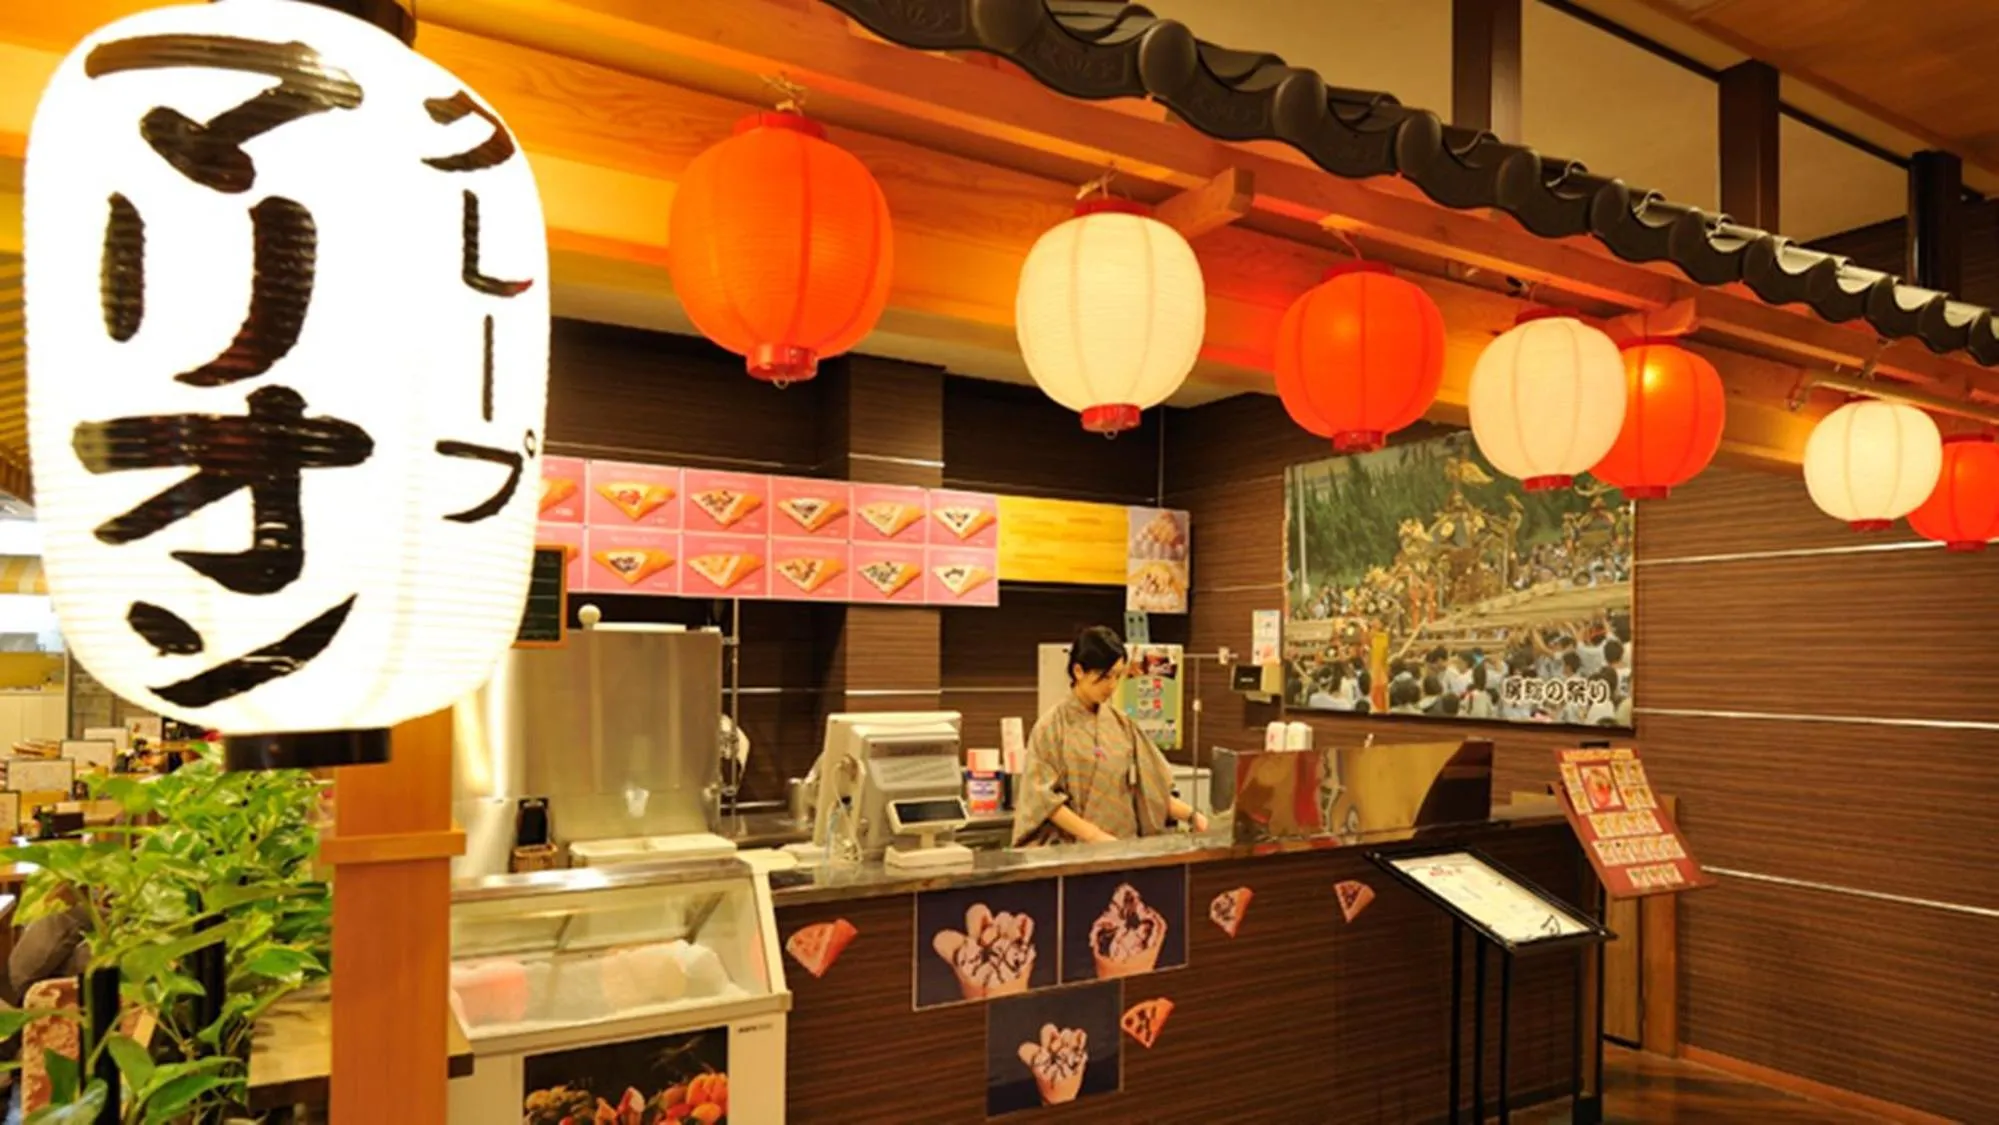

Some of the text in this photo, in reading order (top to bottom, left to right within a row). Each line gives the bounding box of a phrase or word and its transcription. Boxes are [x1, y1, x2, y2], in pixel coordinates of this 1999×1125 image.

[72, 34, 375, 709] マリオン
[420, 90, 538, 524] クレープ
